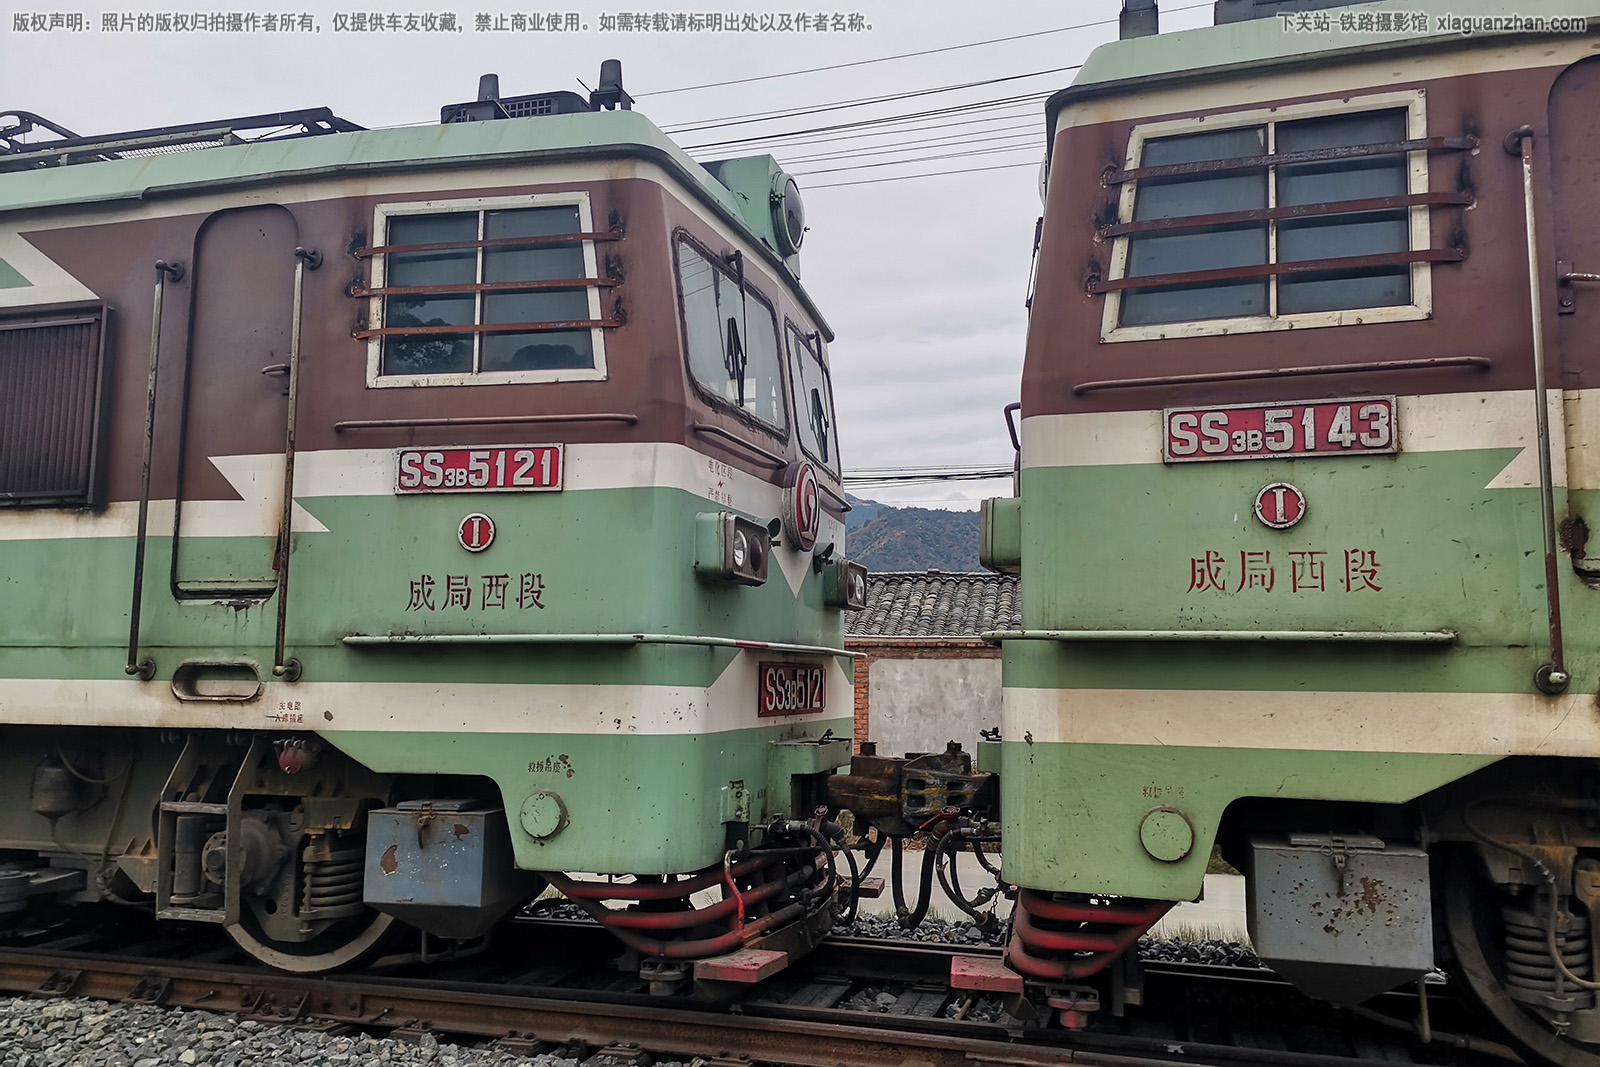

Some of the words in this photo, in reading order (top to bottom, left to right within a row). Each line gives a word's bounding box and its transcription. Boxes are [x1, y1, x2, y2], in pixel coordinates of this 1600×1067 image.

[1187, 548, 1383, 593] 成局西段
[405, 572, 546, 612] 成局西段
